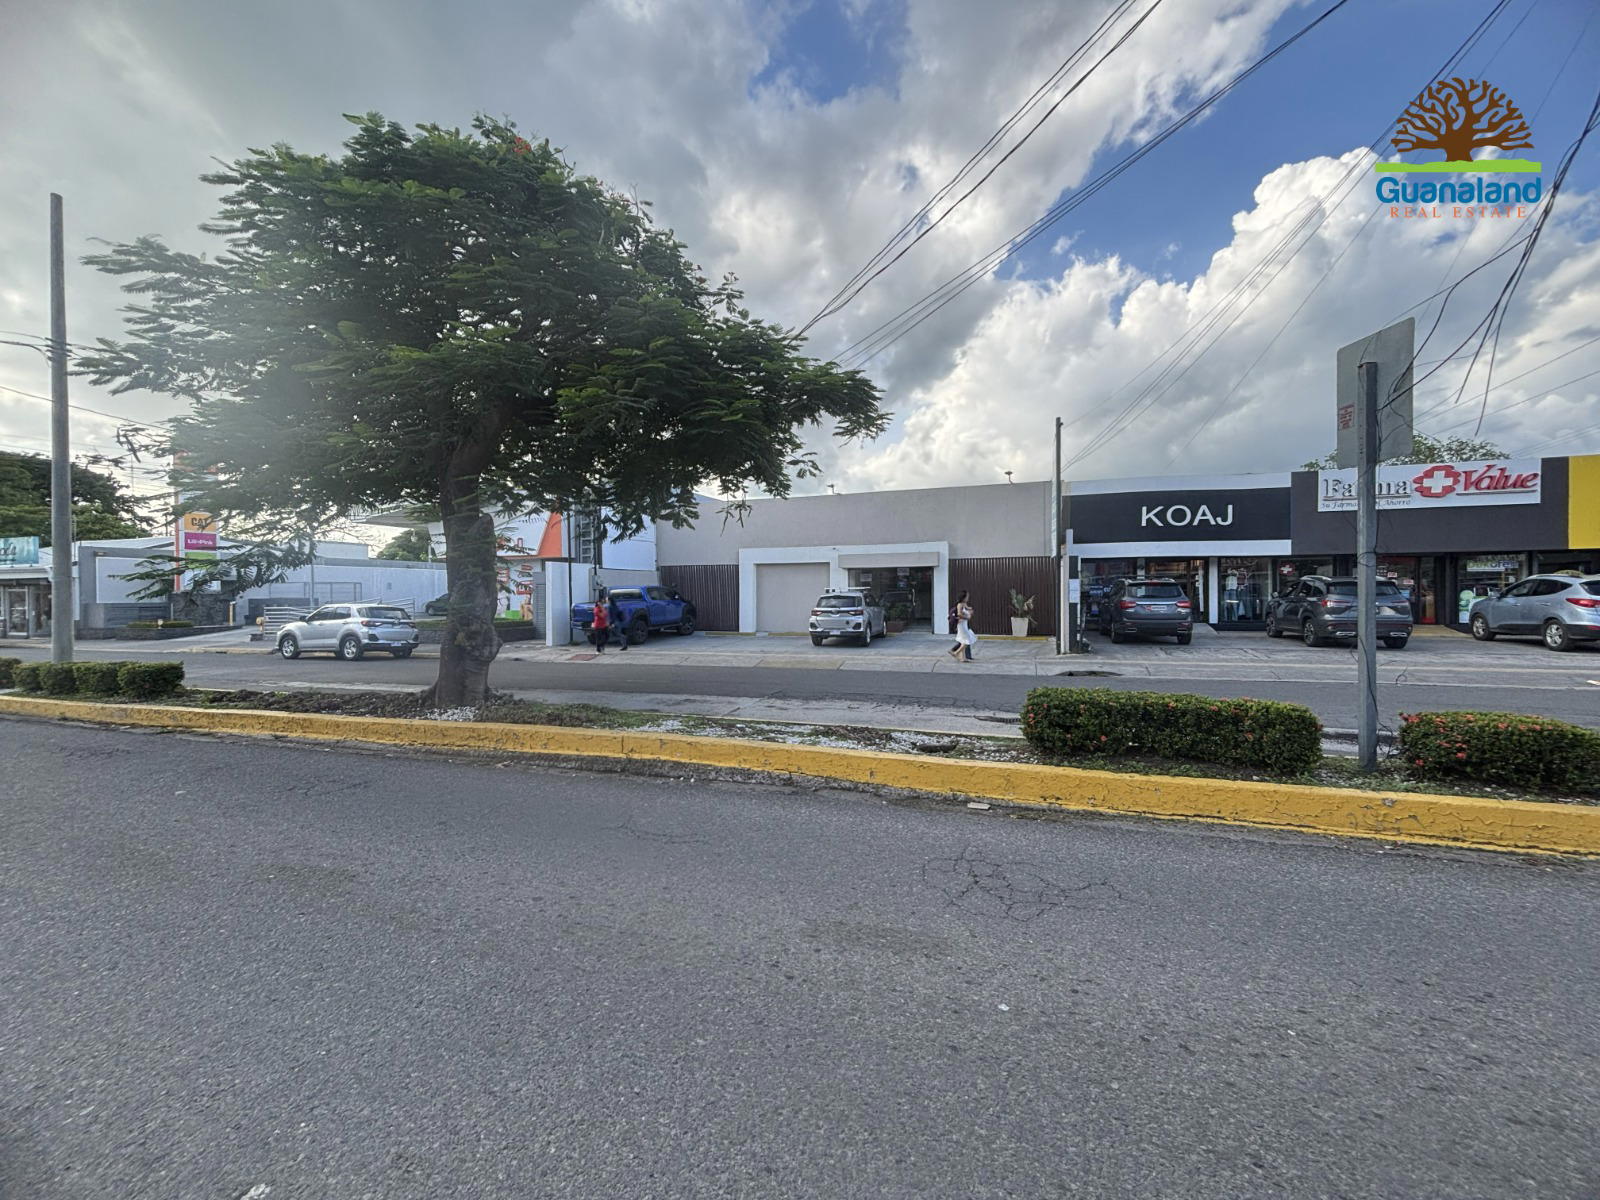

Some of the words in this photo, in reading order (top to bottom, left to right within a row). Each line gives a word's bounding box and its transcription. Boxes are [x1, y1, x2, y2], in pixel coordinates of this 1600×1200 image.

[1323, 478, 1411, 497] Fama
[1462, 464, 1540, 492] Value
[1141, 504, 1233, 527] KOAJ
